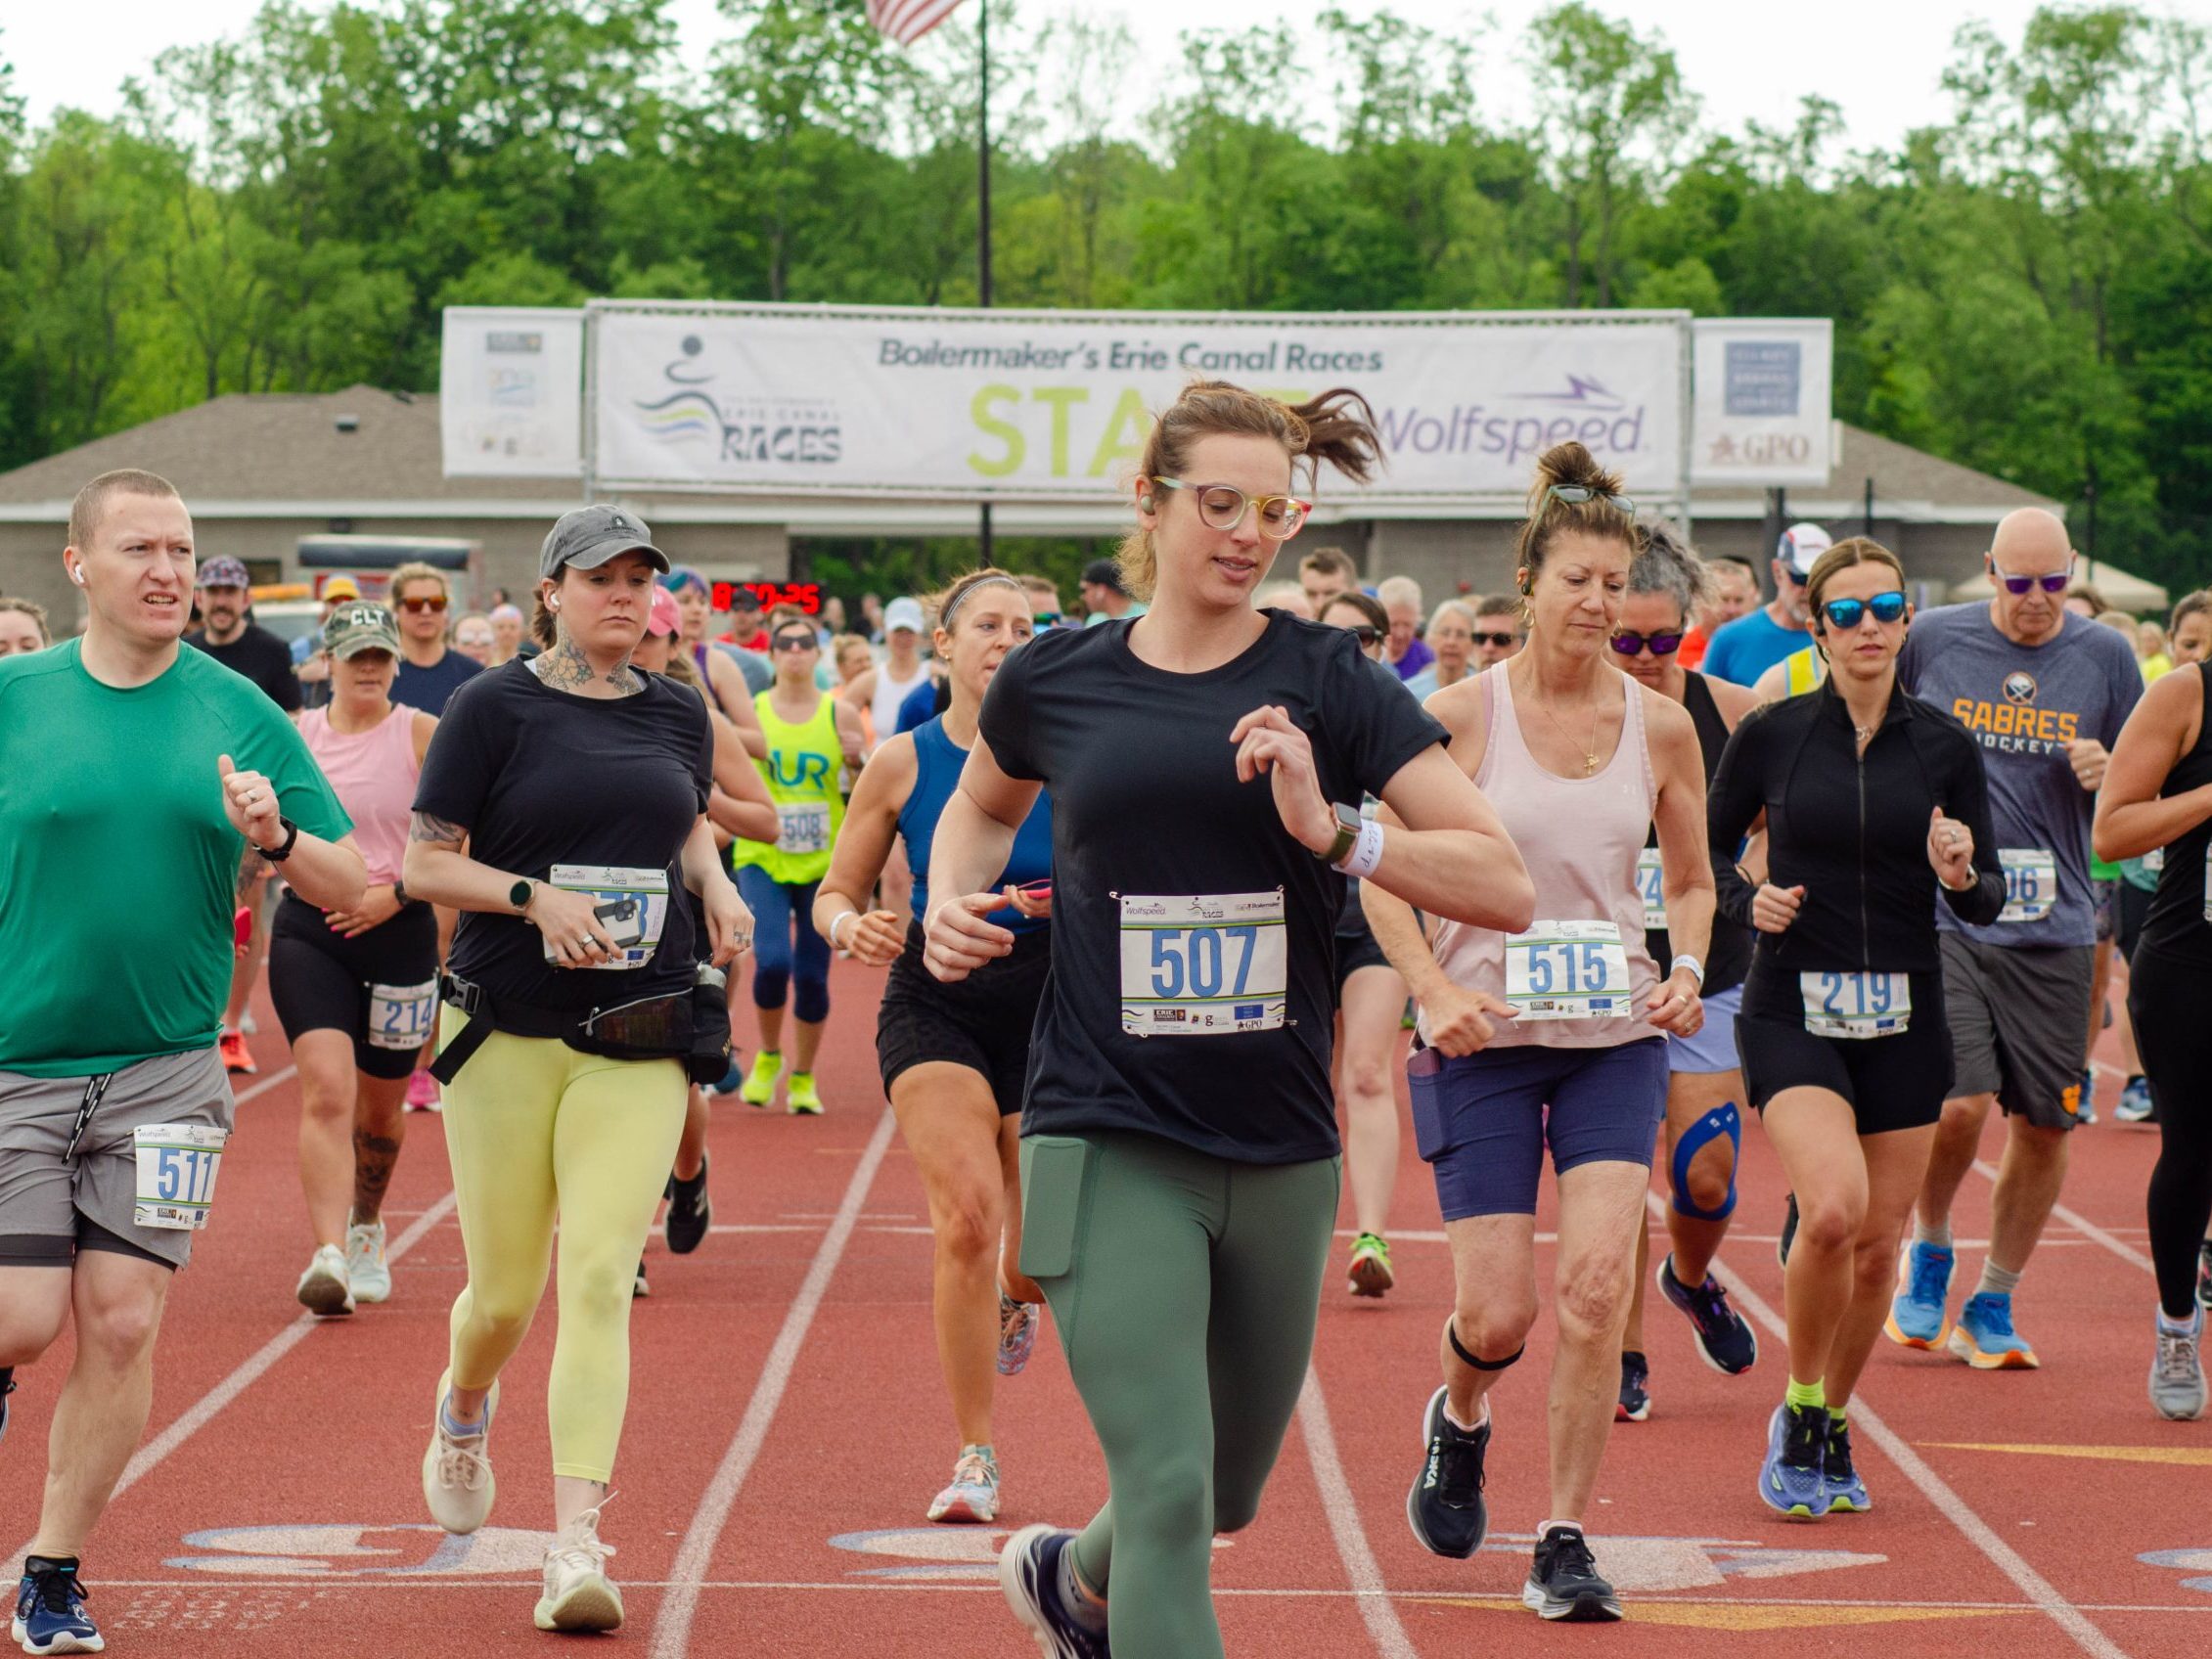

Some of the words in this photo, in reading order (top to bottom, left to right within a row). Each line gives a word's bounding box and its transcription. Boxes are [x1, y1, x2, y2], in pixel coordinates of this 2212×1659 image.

[880, 338, 1099, 370] Boilermaker's
[1108, 342, 1168, 371] Erie
[1179, 341, 1275, 371] Canal
[1286, 343, 1383, 372] Races
[1377, 406, 1645, 465] Wolfspeed
[1744, 434, 1810, 464] GPO
[351, 608, 384, 626] CLT
[1953, 697, 2080, 742] SABRES
[1976, 733, 2054, 754] OCKEY
[1151, 925, 1257, 998] 507
[1528, 943, 1607, 994] 515
[1822, 970, 1891, 1015] 219
[384, 998, 432, 1033] 214
[158, 1147, 213, 1202] 511
